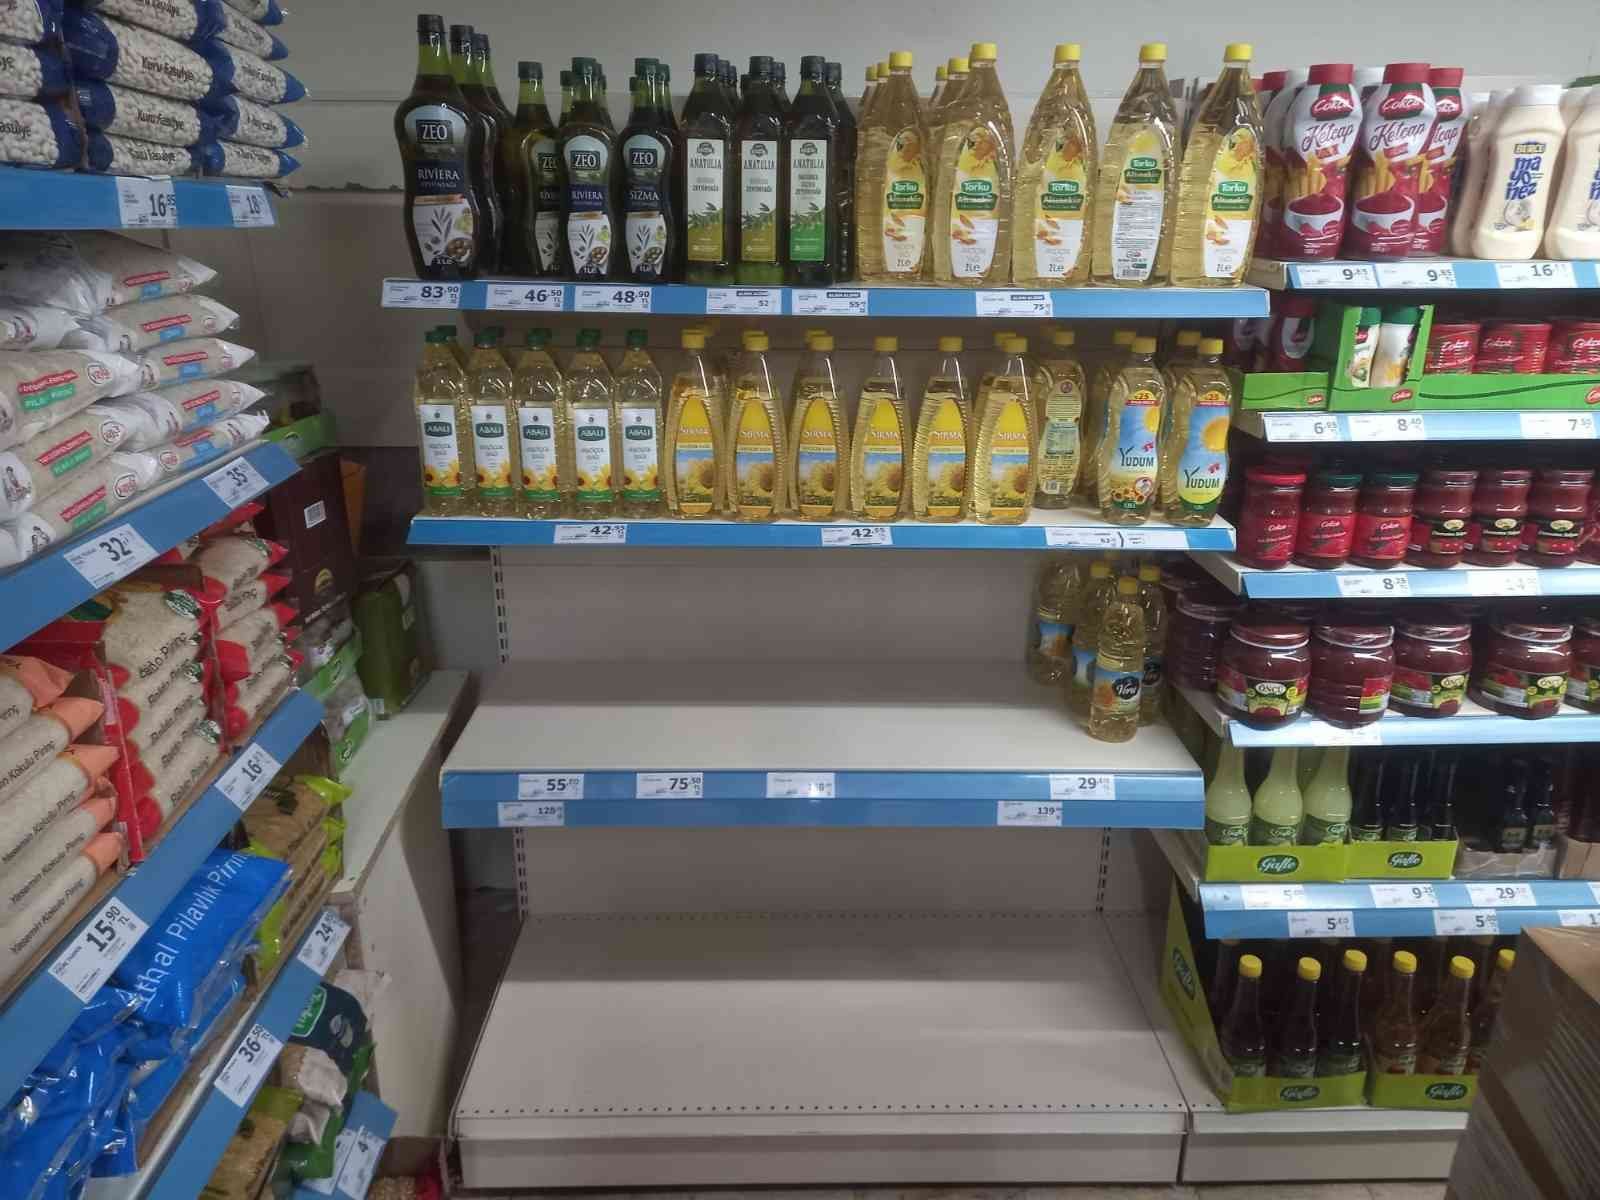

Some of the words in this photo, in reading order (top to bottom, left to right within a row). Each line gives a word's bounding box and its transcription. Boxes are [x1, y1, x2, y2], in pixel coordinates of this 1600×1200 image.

[422, 124, 448, 140] ZEO
[575, 154, 598, 168] ZEO
[631, 151, 654, 166] ZEO
[417, 168, 460, 181] RIVIERA
[963, 182, 990, 192] Torku
[1050, 182, 1077, 193] Torku
[1505, 181, 1538, 200] nez
[571, 190, 604, 201] RIVIERA
[166, 883, 223, 941] Pilavlık
